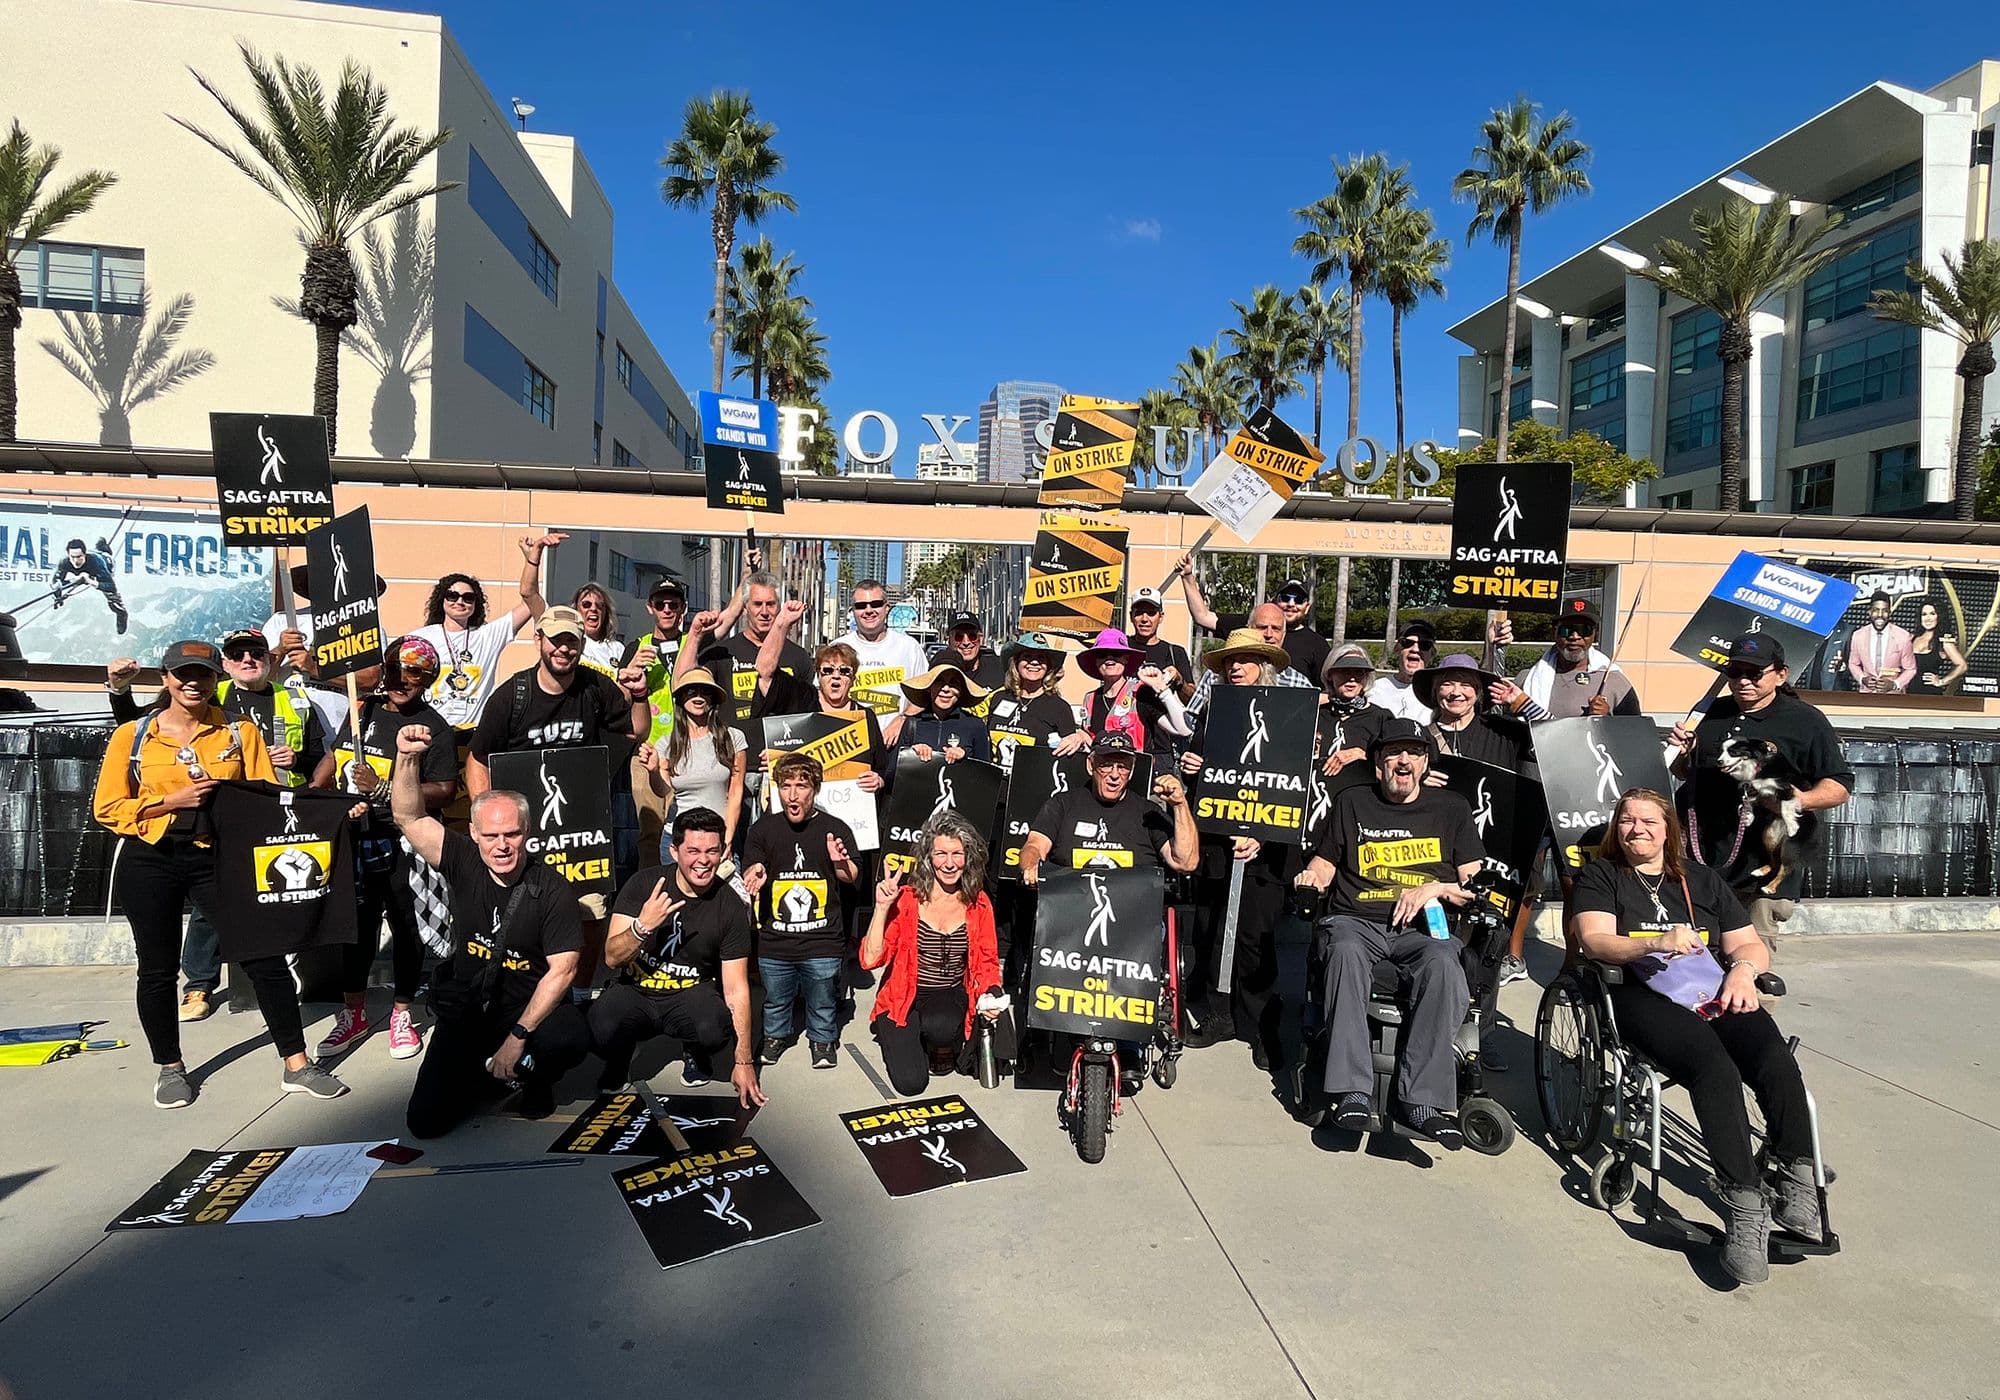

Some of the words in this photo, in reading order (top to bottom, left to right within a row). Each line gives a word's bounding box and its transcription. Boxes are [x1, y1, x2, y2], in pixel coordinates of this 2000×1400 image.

[722, 407, 757, 420] WGAW
[716, 427, 746, 444] STANDS
[748, 431, 767, 447] WITH
[1054, 456, 1072, 474] ON
[1075, 446, 1124, 470] STRIKE
[1234, 440, 1255, 461] ON
[1256, 447, 1308, 477] STRIKE
[726, 494, 768, 507] STRIKE!
[266, 506, 289, 516] ON
[124, 531, 263, 579] FORCES
[22, 571, 51, 583] TEST
[1493, 566, 1515, 577] ON
[1035, 580, 1056, 599] ON
[1060, 571, 1112, 595] STRIKE
[1452, 575, 1559, 600] STRIKE!
[1762, 569, 1819, 596] WGAW
[1856, 569, 1925, 598] SPEAK
[1733, 586, 1782, 612] STANDS
[1780, 601, 1816, 625] WITH
[338, 623, 351, 637] ON
[317, 627, 380, 666] STRIKE!
[737, 675, 753, 688] ON
[864, 669, 903, 686] STRIKE
[1237, 788, 1259, 802] ON
[1196, 797, 1303, 829] STRIKE!
[525, 829, 611, 853] G·AFTRA
[543, 852, 567, 865] ON
[1363, 846, 1379, 864] ON
[1383, 842, 1437, 863] STRIKE
[1375, 867, 1389, 880] ON
[1389, 871, 1425, 887] STRIKE
[257, 892, 280, 904] ON
[771, 920, 786, 932] ON
[1083, 976, 1108, 993] ON
[1034, 985, 1155, 1026] STRIKE!
[566, 1094, 637, 1152] STRIKE!
[848, 1101, 967, 1132] STRIKE!
[904, 1118, 927, 1127] ON
[622, 1144, 758, 1192] STRIKE!
[684, 1167, 713, 1178] ON
[195, 1150, 286, 1223] STRIKE!
[204, 1176, 230, 1194] ON
